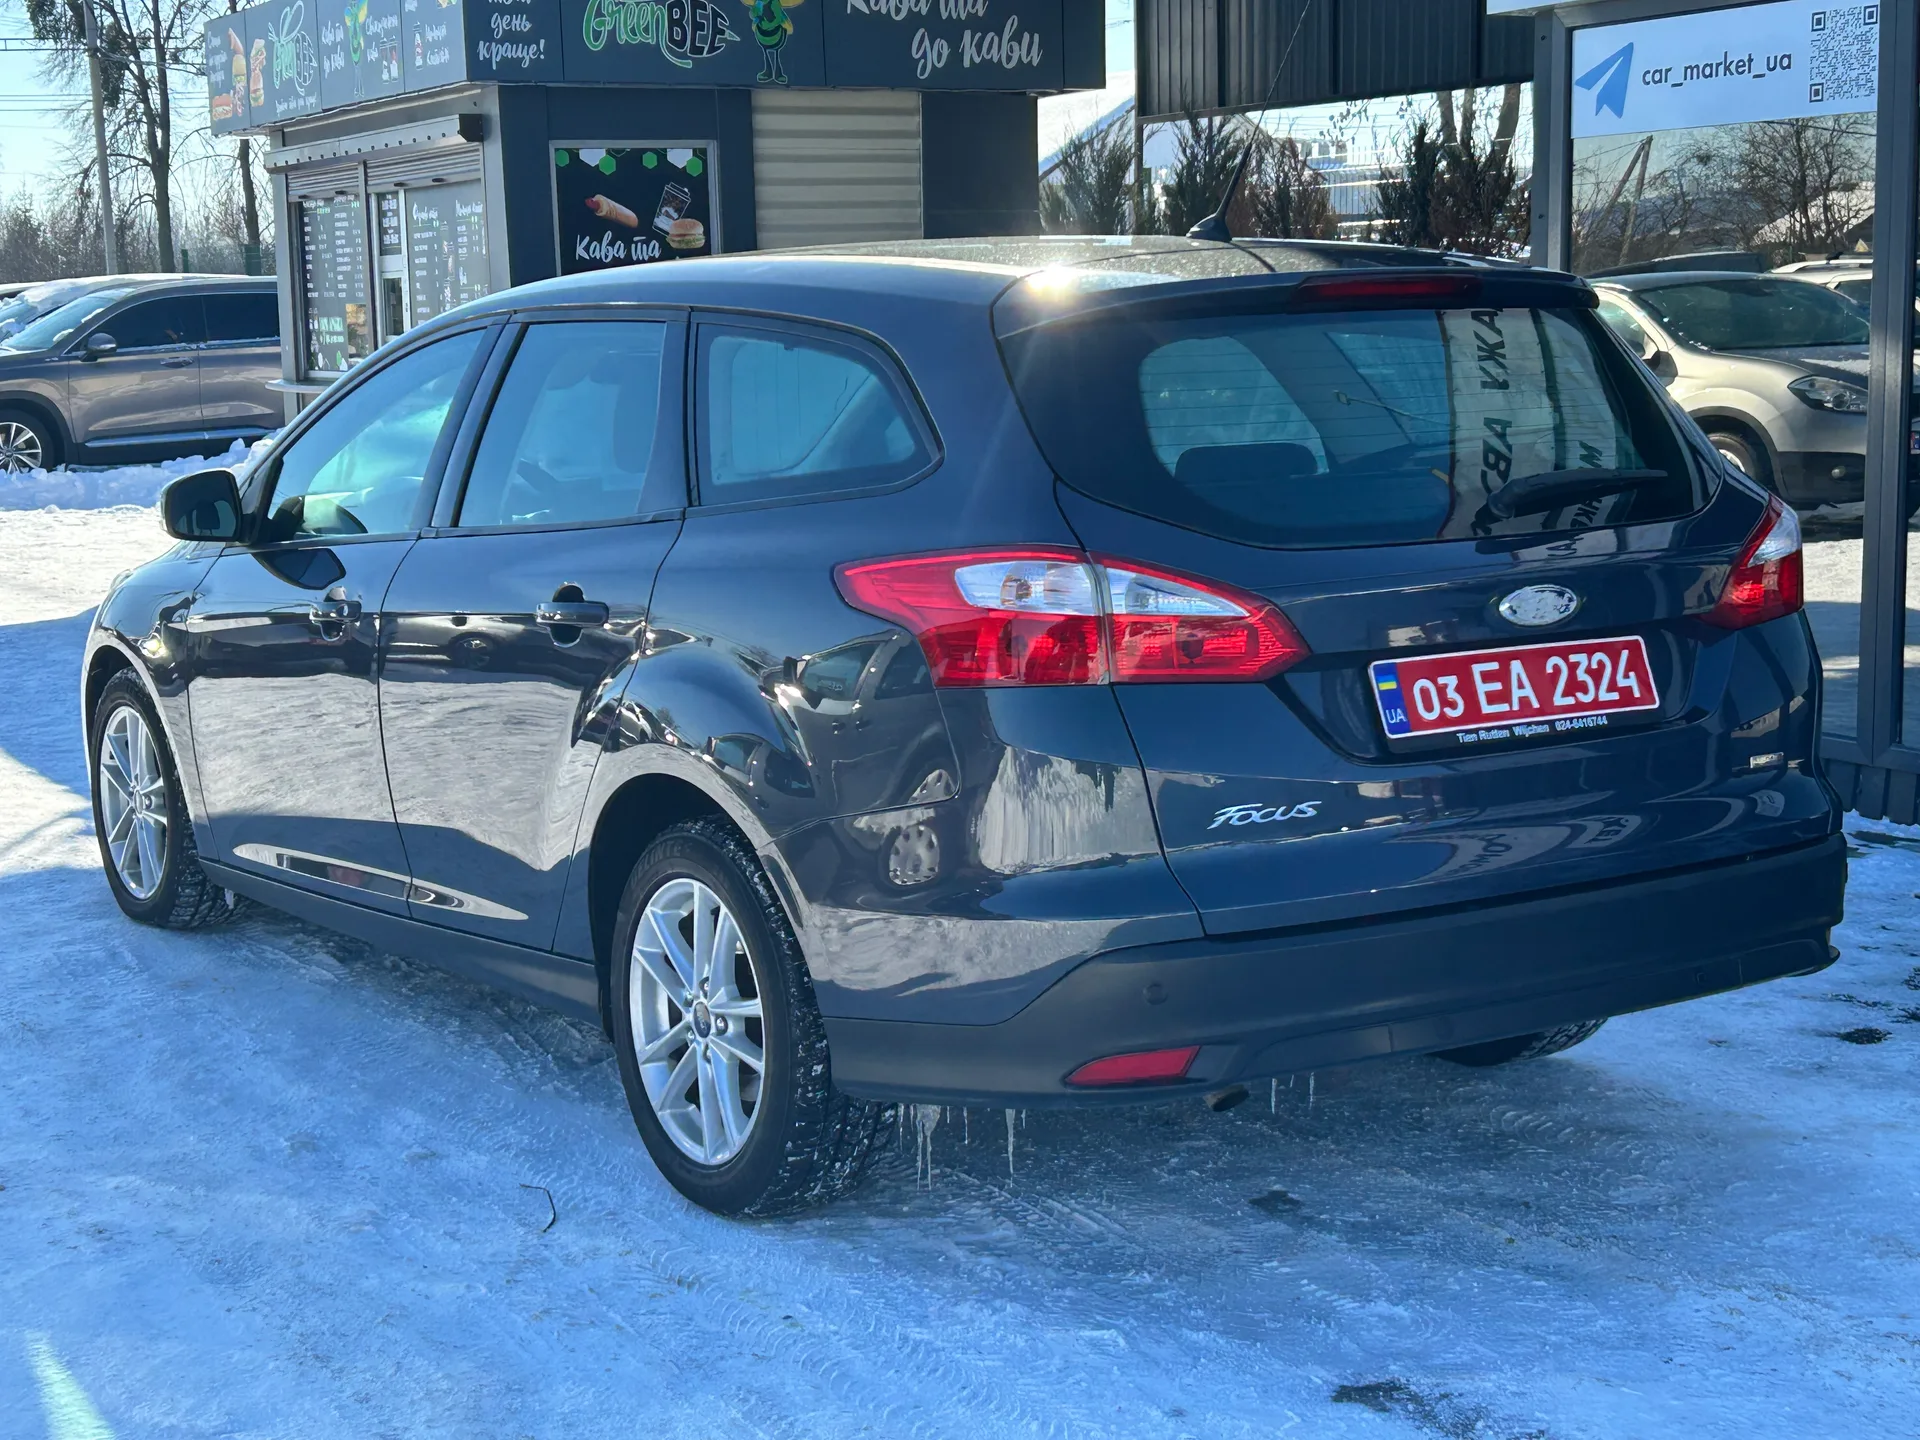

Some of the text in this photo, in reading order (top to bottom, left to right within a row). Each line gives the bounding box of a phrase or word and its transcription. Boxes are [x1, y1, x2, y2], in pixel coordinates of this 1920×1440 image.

[490, 12, 532, 39] день
[477, 38, 545, 70] краще!
[911, 14, 1043, 80] до кави
[1641, 51, 1793, 88] car_market_ua
[575, 230, 662, 264] Кава та
[1412, 649, 1641, 721] 03 EA 2324
[1385, 707, 1407, 724] UA
